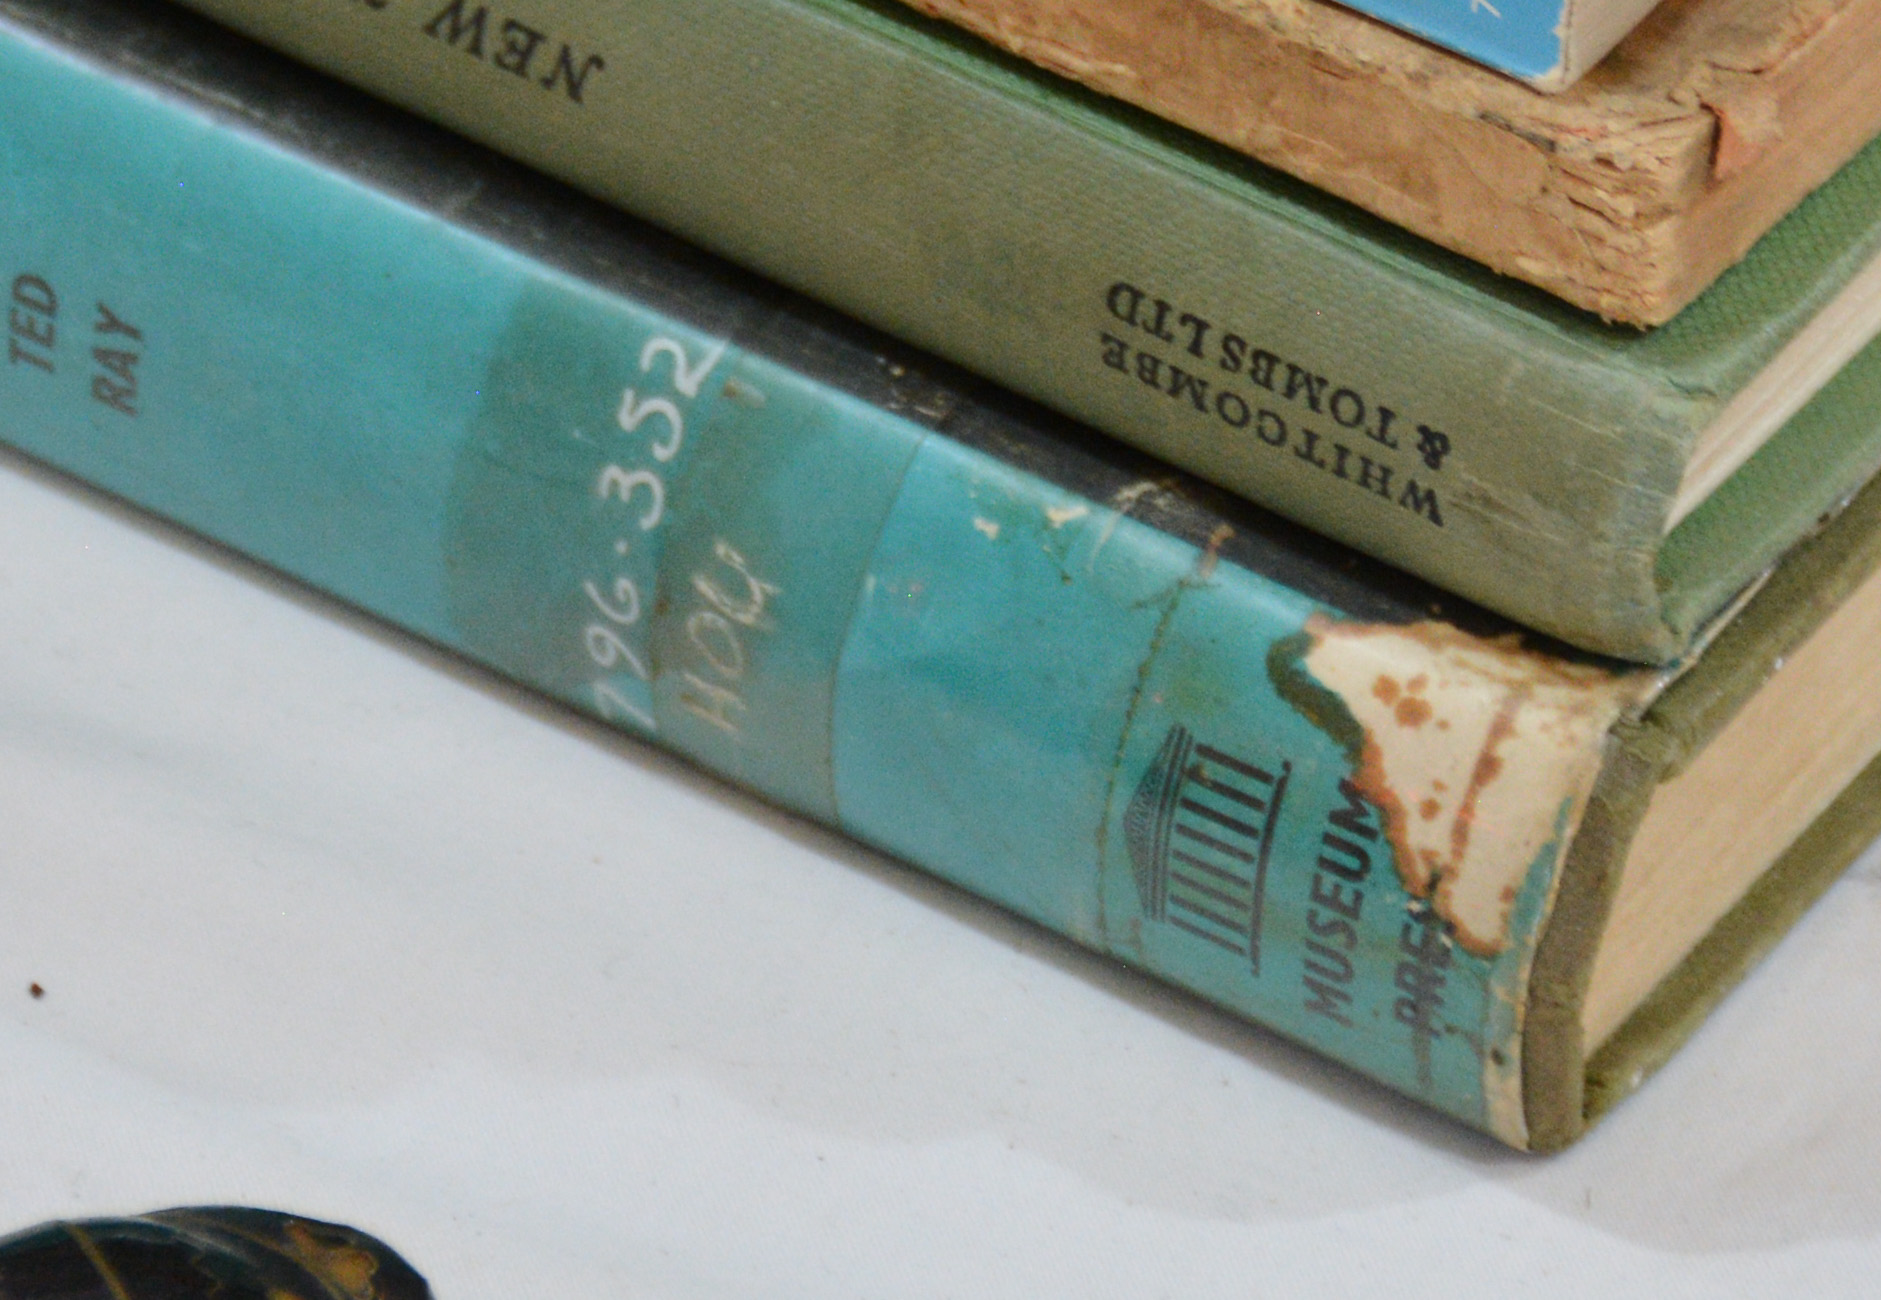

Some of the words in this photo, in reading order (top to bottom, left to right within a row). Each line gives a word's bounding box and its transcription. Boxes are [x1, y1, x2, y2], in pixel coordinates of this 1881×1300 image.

[9, 272, 58, 373] TED
[91, 302, 143, 417] RAY
[1106, 283, 1212, 358] LTD
[1100, 332, 1444, 527] WHITCOMBE
[1220, 334, 1399, 449] TOMBS
[1415, 424, 1452, 470] &
[1303, 778, 1379, 1027] MUSEUM
